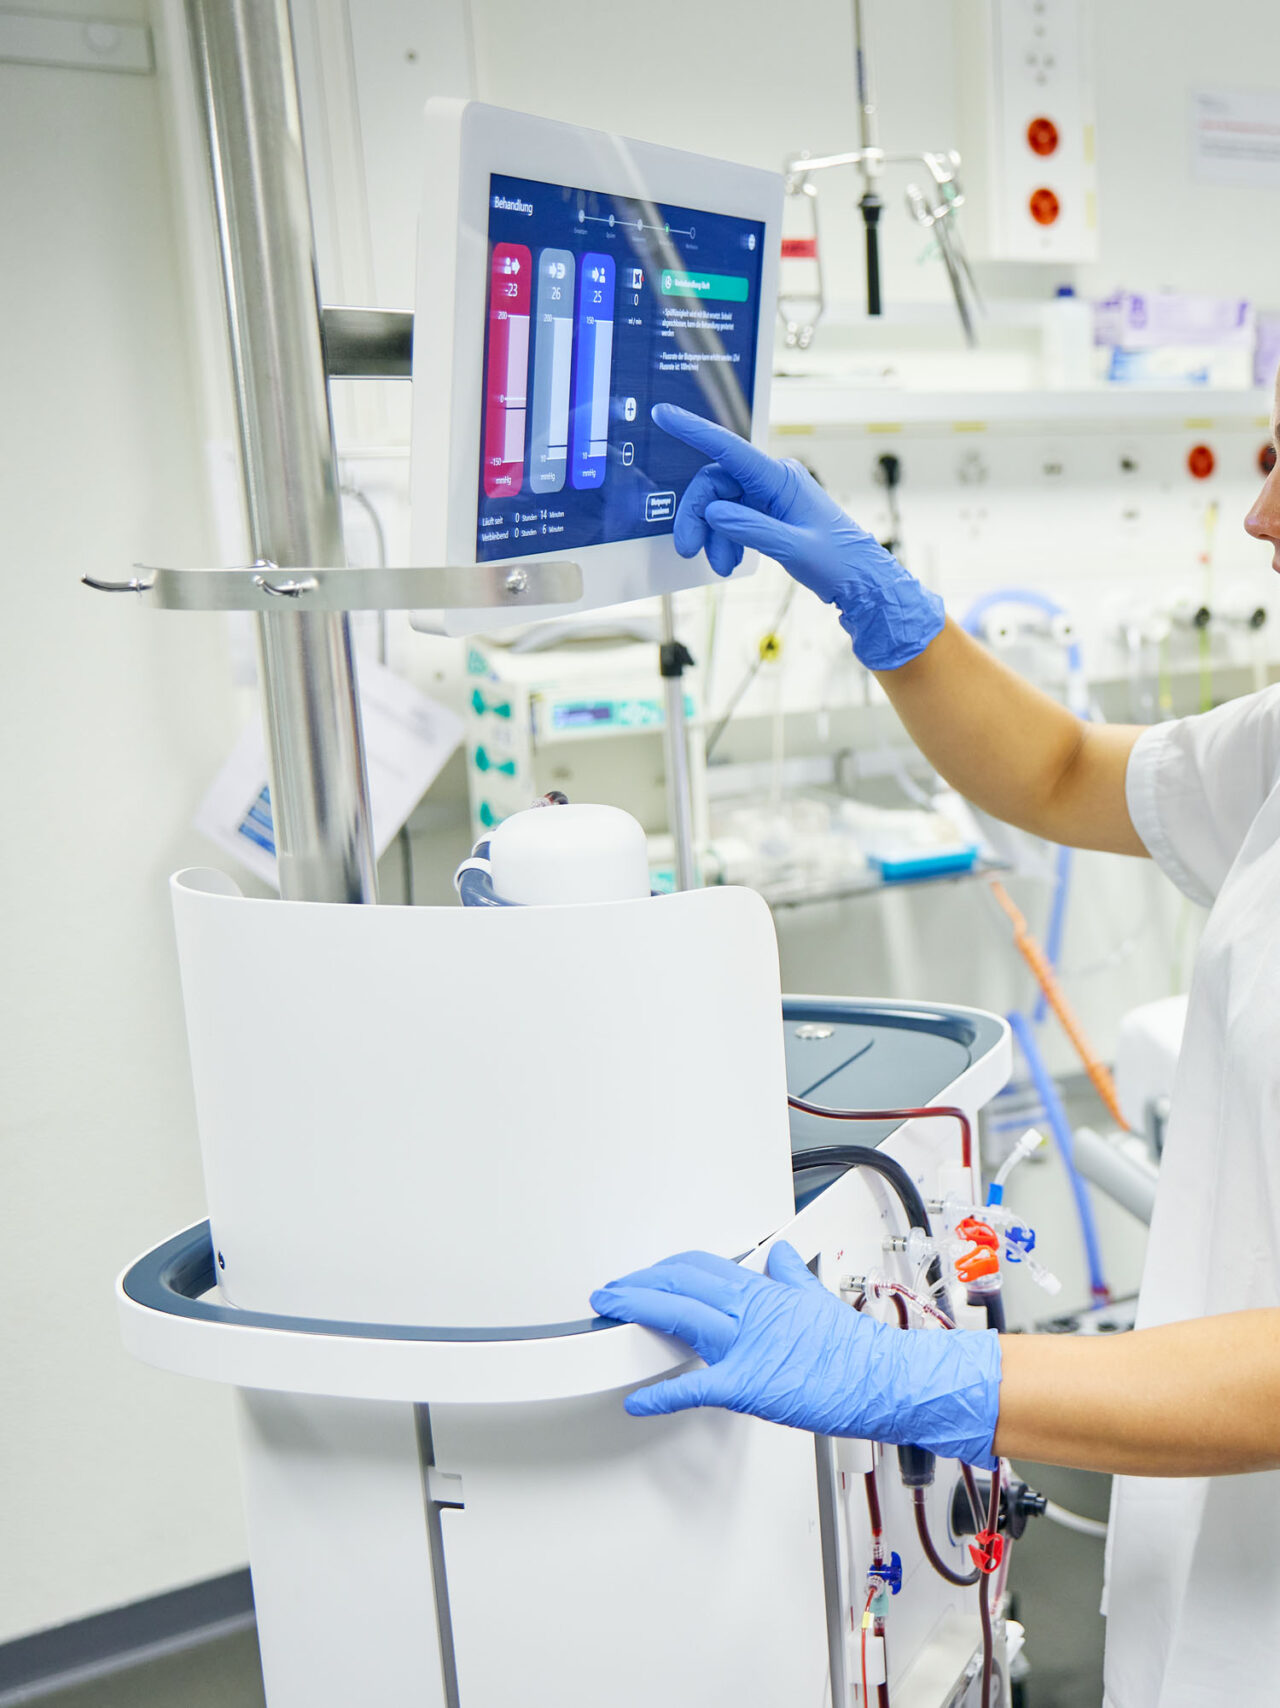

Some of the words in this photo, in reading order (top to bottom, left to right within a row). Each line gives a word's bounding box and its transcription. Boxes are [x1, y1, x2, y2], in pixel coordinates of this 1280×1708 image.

[493, 195, 533, 217] Behandlung
[505, 283, 518, 297] -23
[551, 287, 561, 300] 26
[593, 290, 602, 303] 25
[633, 294, 639, 306] 0
[498, 311, 507, 320] 200
[544, 313, 553, 322] 200
[586, 316, 594, 325] 150
[490, 457, 502, 466] -150
[540, 472, 556, 482] mmHg
[582, 469, 597, 479] mmHg
[495, 476, 512, 486] mmHg
[482, 517, 494, 527] Läuft
[495, 516, 504, 525] seit
[515, 512, 520, 523] 0
[521, 514, 538, 522] Stunden
[540, 509, 548, 519] 14
[549, 511, 565, 519] Minuten
[481, 530, 509, 542] Verbleibend
[514, 527, 519, 538] 0
[521, 528, 538, 537] Stunden
[542, 524, 547, 534] 6
[548, 525, 564, 533] Minuten
